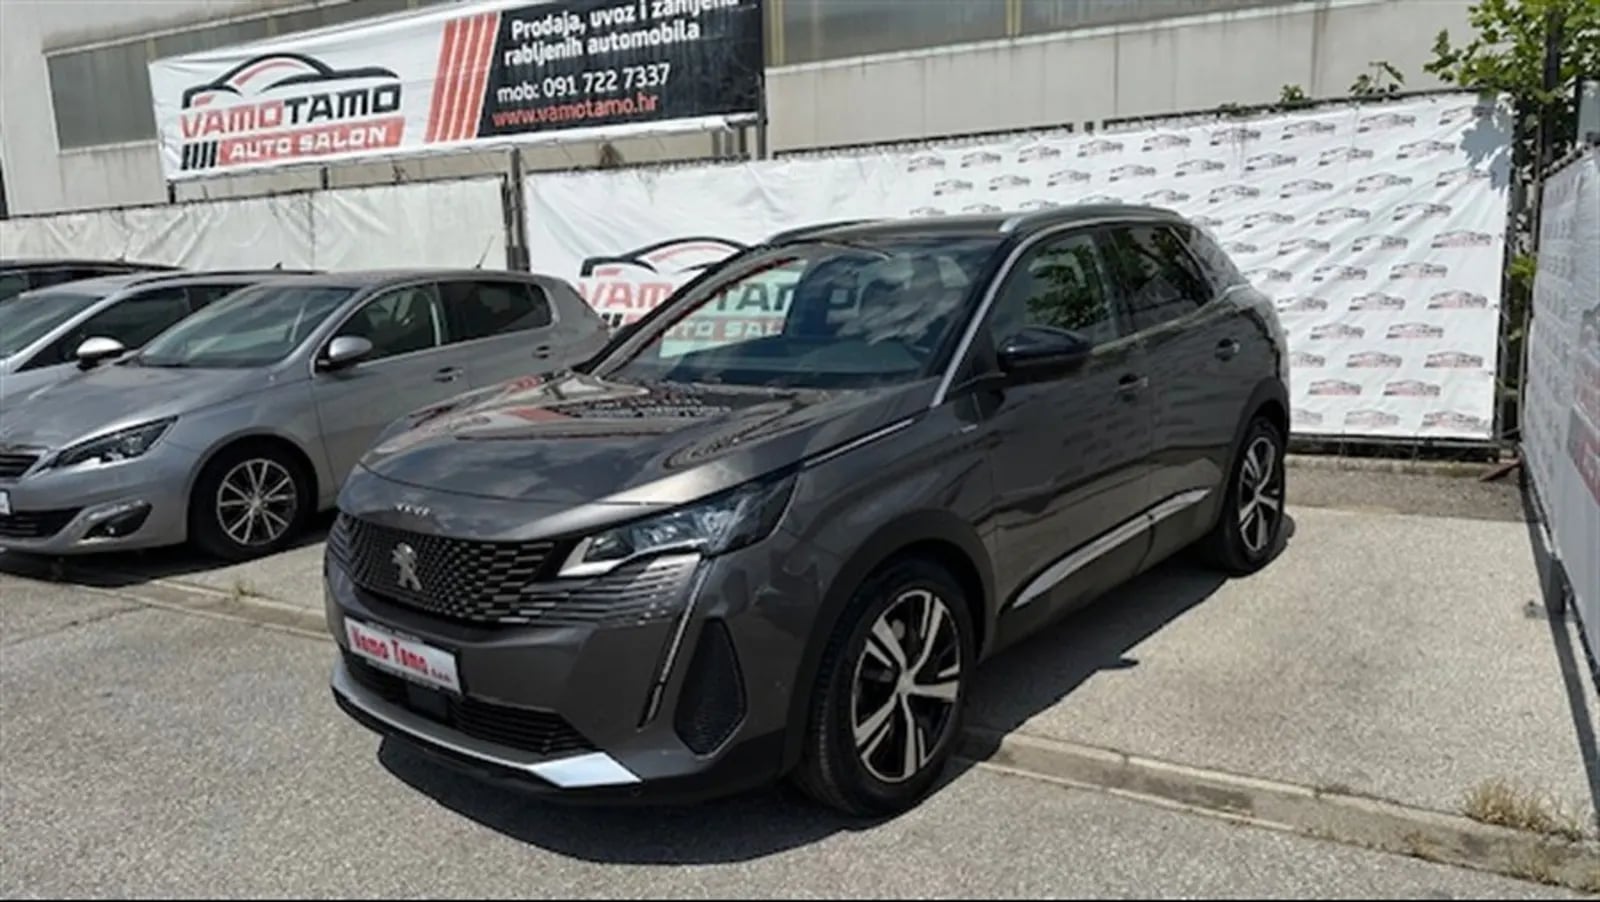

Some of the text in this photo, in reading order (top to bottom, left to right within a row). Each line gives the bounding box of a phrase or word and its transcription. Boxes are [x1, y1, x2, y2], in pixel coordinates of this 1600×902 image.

[511, 10, 586, 41] Prodaja,
[590, 5, 636, 28] uvoz
[640, 0, 647, 20] i
[504, 19, 700, 67] rabljenih automobila
[497, 63, 670, 103] mob: 091 722 7337
[491, 92, 658, 127] www.vamotamo.hr
[229, 125, 388, 161] AUTO SALON
